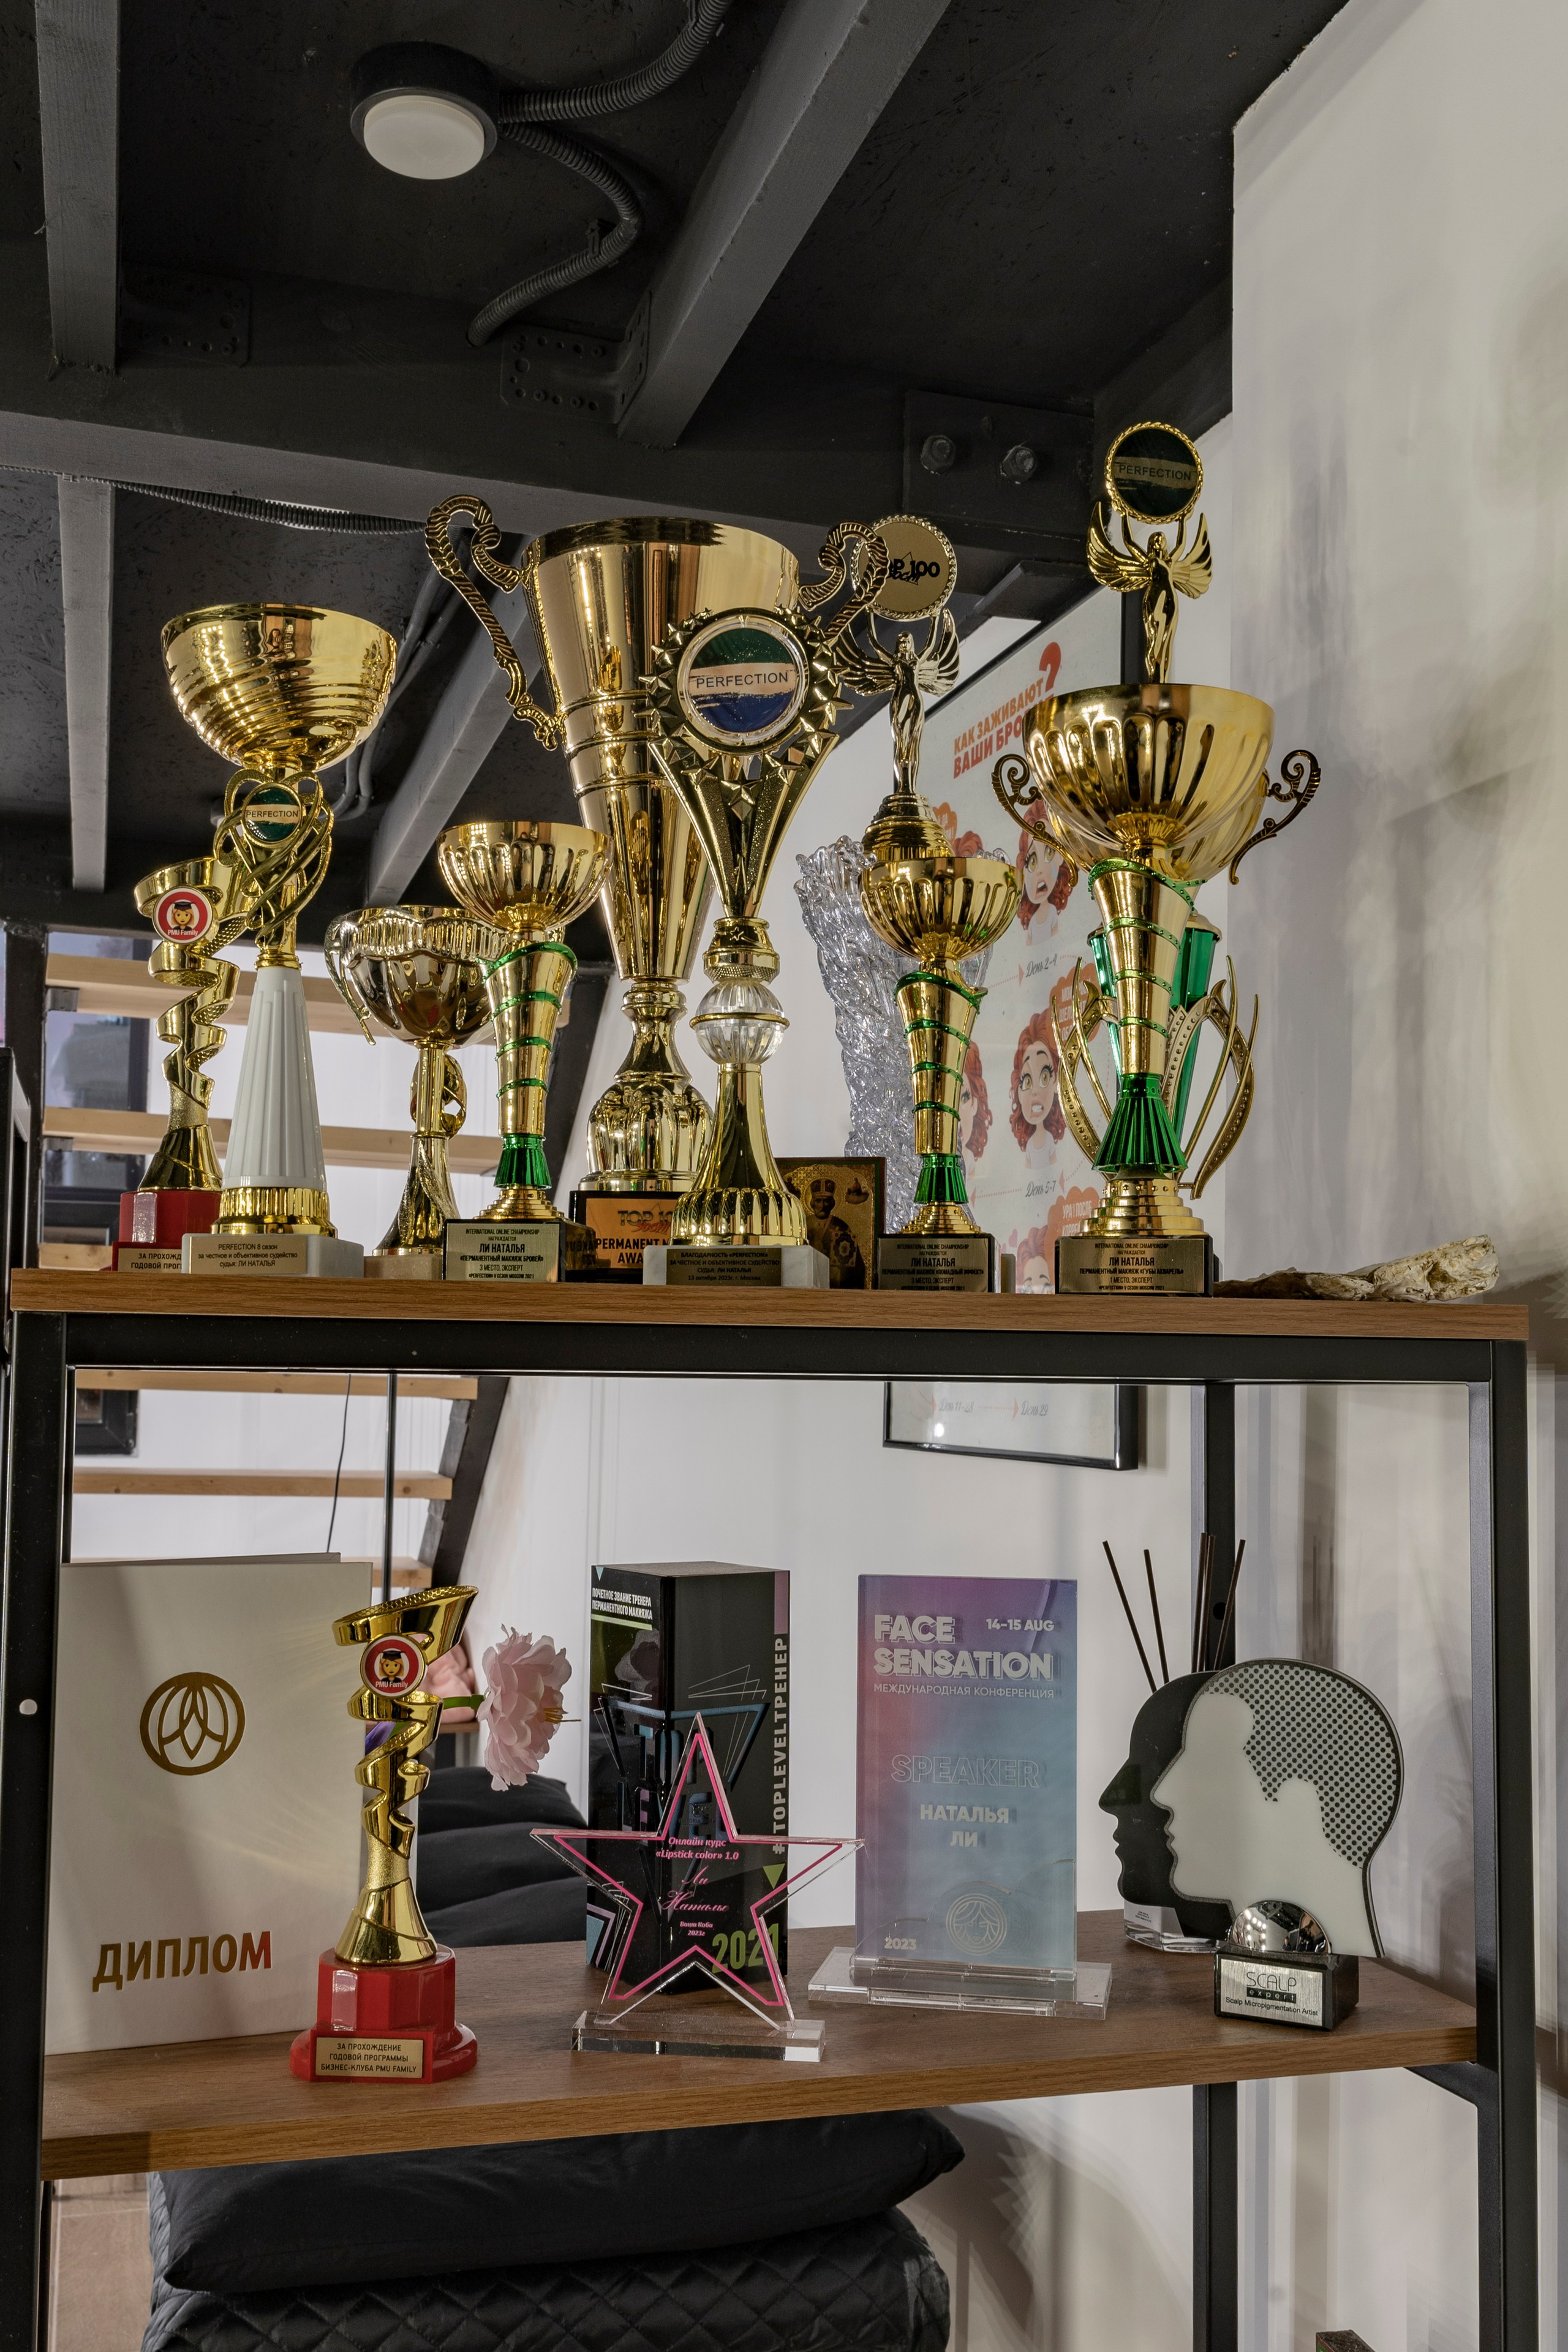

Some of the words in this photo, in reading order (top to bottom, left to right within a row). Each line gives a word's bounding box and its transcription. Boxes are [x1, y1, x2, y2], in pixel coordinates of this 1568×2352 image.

[1118, 464, 1191, 481] PERFECTION
[910, 560, 940, 578] 100
[696, 672, 788, 688] PERFECTION
[954, 726, 975, 756] КАК
[978, 677, 1044, 740] ЗАЖИВАЮТ
[954, 734, 993, 779] ВАШИ
[1026, 960, 1043, 978] День
[1025, 1181, 1044, 1197] День
[1045, 1180, 1057, 1194] 5-7
[617, 1210, 654, 1226] TOP
[479, 1243, 490, 1253] ЛИ
[491, 1243, 526, 1253] НАТАЛЬЯ
[596, 1238, 660, 1250] PERMANENT
[911, 1257, 921, 1267] ЛИ
[922, 1257, 956, 1267] НАТАЛЬЯ
[1109, 1257, 1120, 1266] ЛИ
[1121, 1257, 1155, 1266] НАТАЛЬЯ
[1020, 1400, 1039, 1416] День
[1039, 1404, 1049, 1417] 29
[592, 1588, 614, 1600] ПОЧЕТНОЕ
[614, 1591, 632, 1604] ЗВАНИЕ
[632, 1594, 652, 1607] ТРЕНЕРА
[592, 1600, 628, 1615] ПЕРМАНЕНТНОГО
[628, 1606, 653, 1620] МАКИЯЖА
[874, 1615, 956, 1645] FACE
[1023, 1619, 1055, 1632] AUG
[873, 1647, 1054, 1681] SENSATION
[874, 1683, 971, 1697] МЕЖДУНАРОДНАЯ
[974, 1686, 1055, 1700] КОНФЕРЕНЦИЯ
[890, 1754, 1039, 1789] SPEAKER
[920, 1804, 1009, 1824] НАТАЛЬЯ
[668, 1837, 704, 1846] Онлайн
[705, 1839, 726, 1849] курс
[950, 1831, 978, 1848] ЛИ
[655, 1849, 694, 1860] «Lipstick
[695, 1850, 723, 1860] color»
[725, 1851, 740, 1860] 1.0
[712, 1923, 779, 1973] 2021
[884, 1937, 917, 1951] 2023
[92, 1931, 271, 1993] ДИПЛОМ
[1246, 1972, 1297, 1992] SCALP
[1249, 1989, 1295, 2002] expert
[1225, 1996, 1243, 2007] Scalp
[1244, 2000, 1301, 2015] Micropigmentation
[348, 2043, 402, 2052] ПРОХОЖДЕНИЕ
[329, 2052, 362, 2061] ГОДОВОЙ
[321, 2064, 374, 2072] БИЗНЕС-КЛУБА
